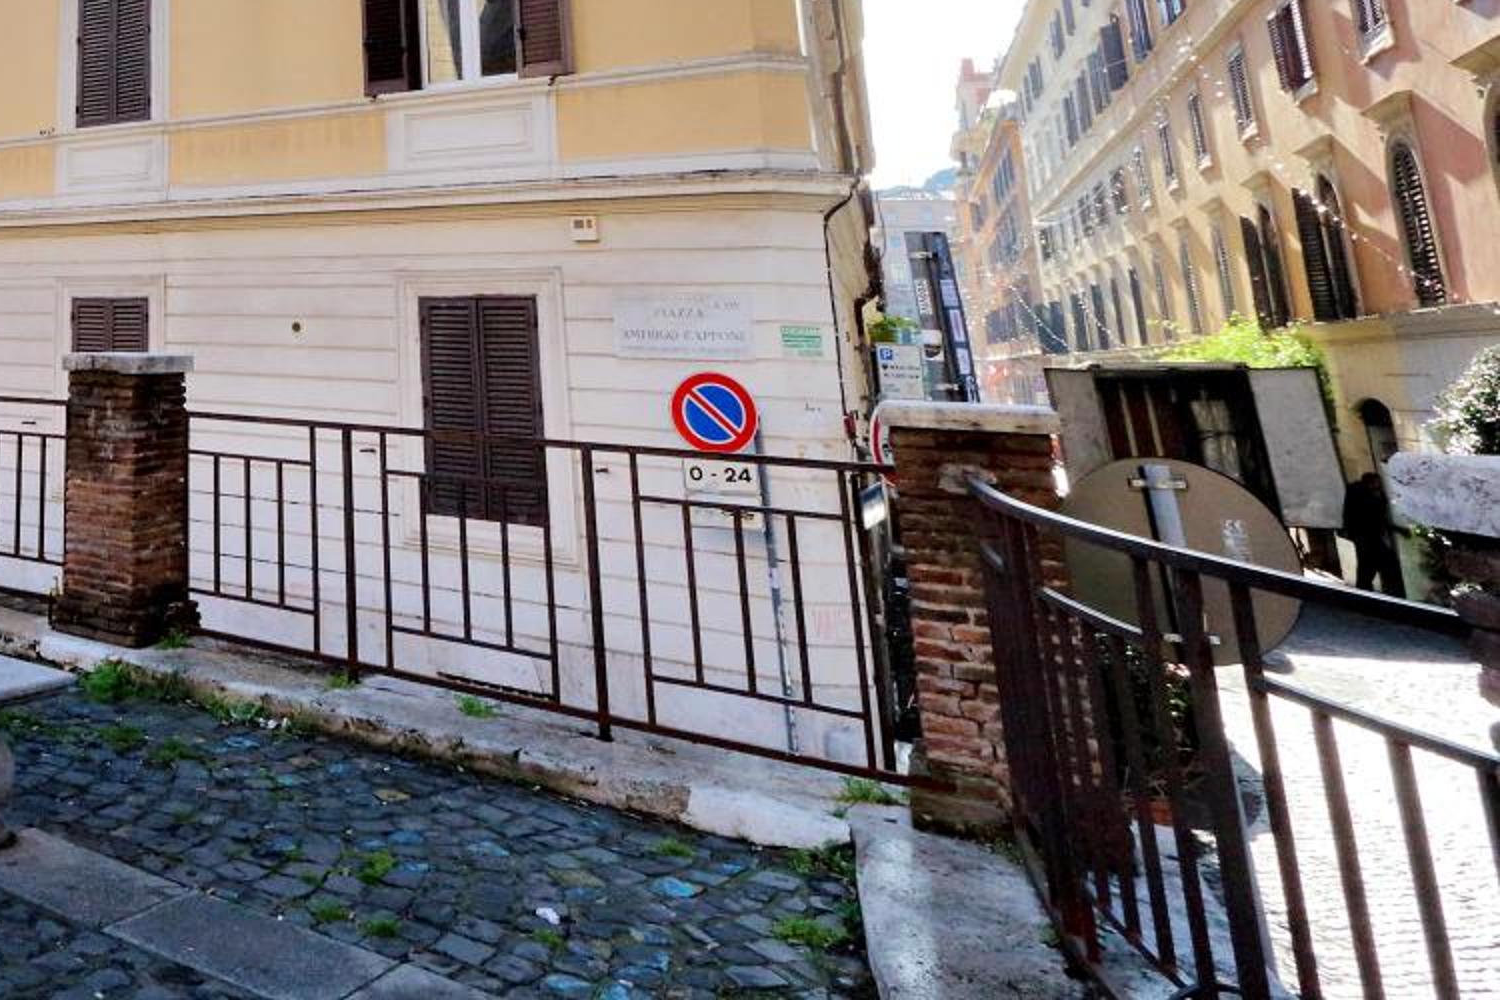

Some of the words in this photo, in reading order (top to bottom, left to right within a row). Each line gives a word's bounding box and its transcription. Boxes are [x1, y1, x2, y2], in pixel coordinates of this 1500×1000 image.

[653, 306, 705, 320] PIAZZA
[689, 466, 703, 481] 0
[723, 467, 752, 483] 24
